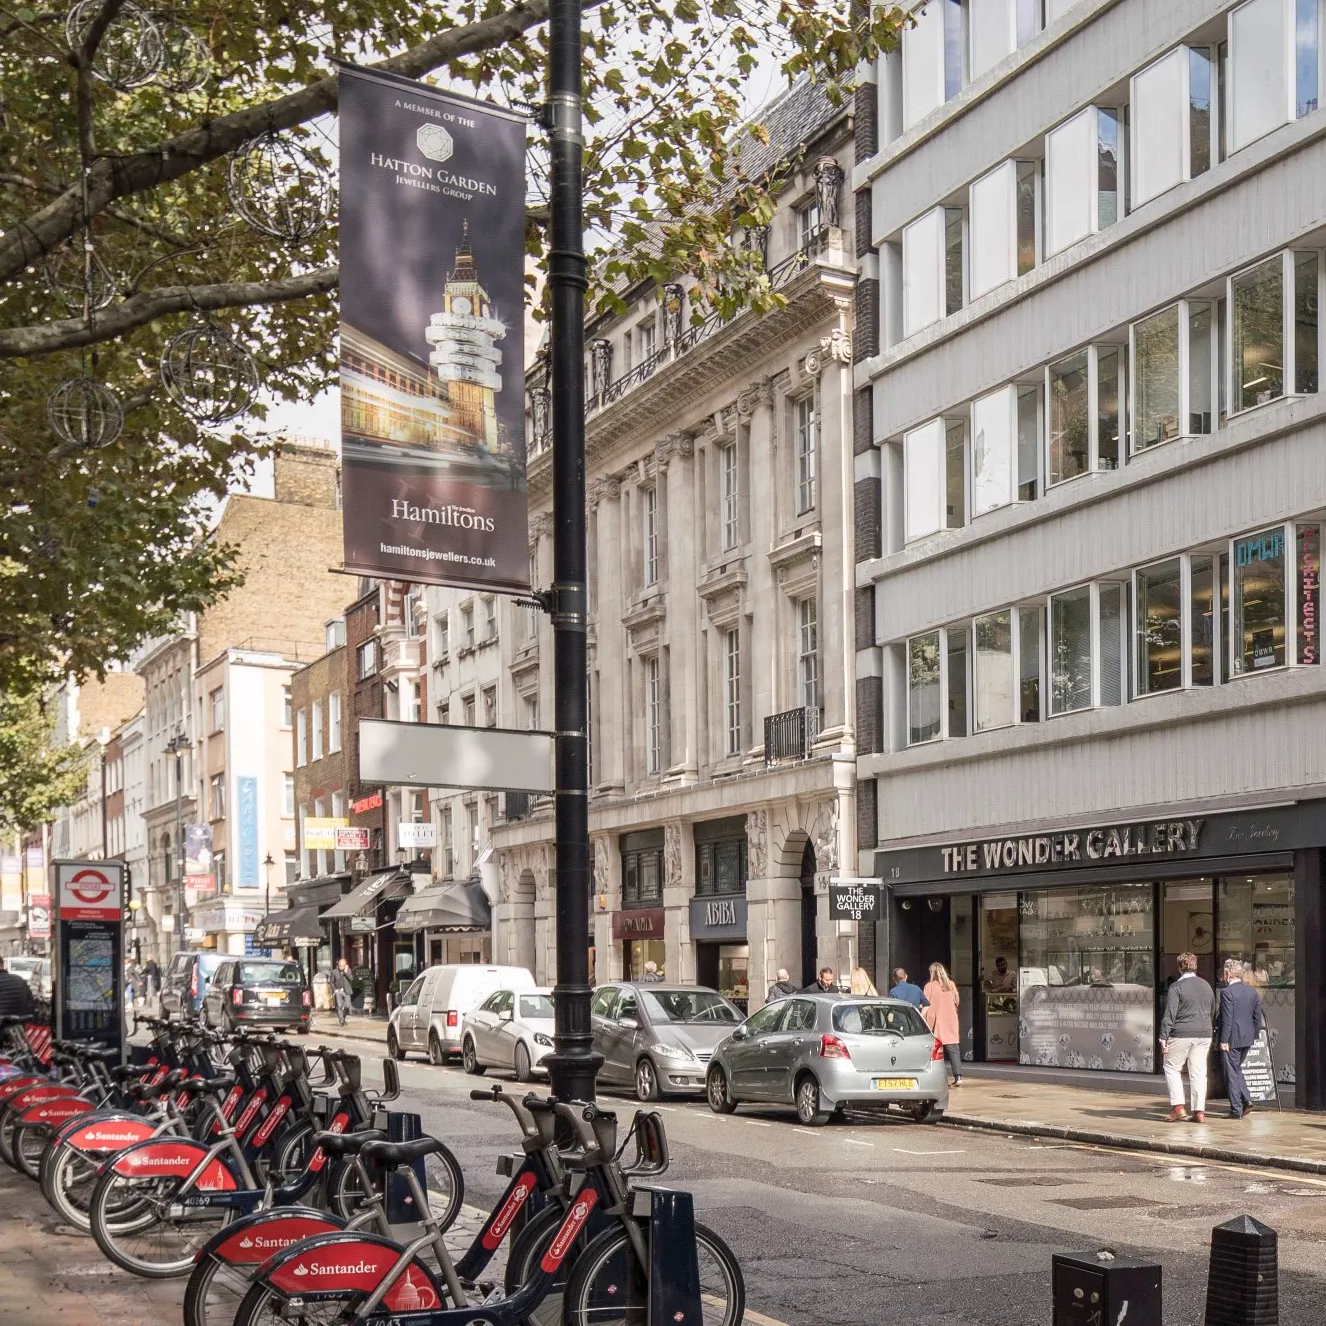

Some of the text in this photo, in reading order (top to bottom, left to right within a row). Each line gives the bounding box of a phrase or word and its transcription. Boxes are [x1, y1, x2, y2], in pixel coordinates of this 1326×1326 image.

[403, 102, 441, 118] MEMBER
[443, 113, 455, 122] OF
[457, 116, 476, 128] THE
[371, 152, 497, 196] HATTON GARDEN
[391, 499, 495, 532] Hamiltons
[380, 542, 496, 567] hamiltonsjewellers.co.uk
[1236, 531, 1285, 568] DMWR
[1254, 646, 1273, 657] DMWR
[941, 819, 1206, 873] THE WONDER GALLERY
[891, 867, 900, 878] 18
[848, 887, 864, 895] THE
[836, 895, 875, 903] WONDER
[704, 900, 736, 926] ABIBA
[836, 902, 875, 911] GALLERY
[850, 910, 862, 920] 18
[95, 1130, 140, 1142] Santander
[141, 1155, 191, 1166] Santander
[184, 1195, 211, 1206] 40269
[255, 1235, 306, 1248] Santan
[556, 1220, 577, 1250] Santander
[310, 1260, 378, 1276] Santander
